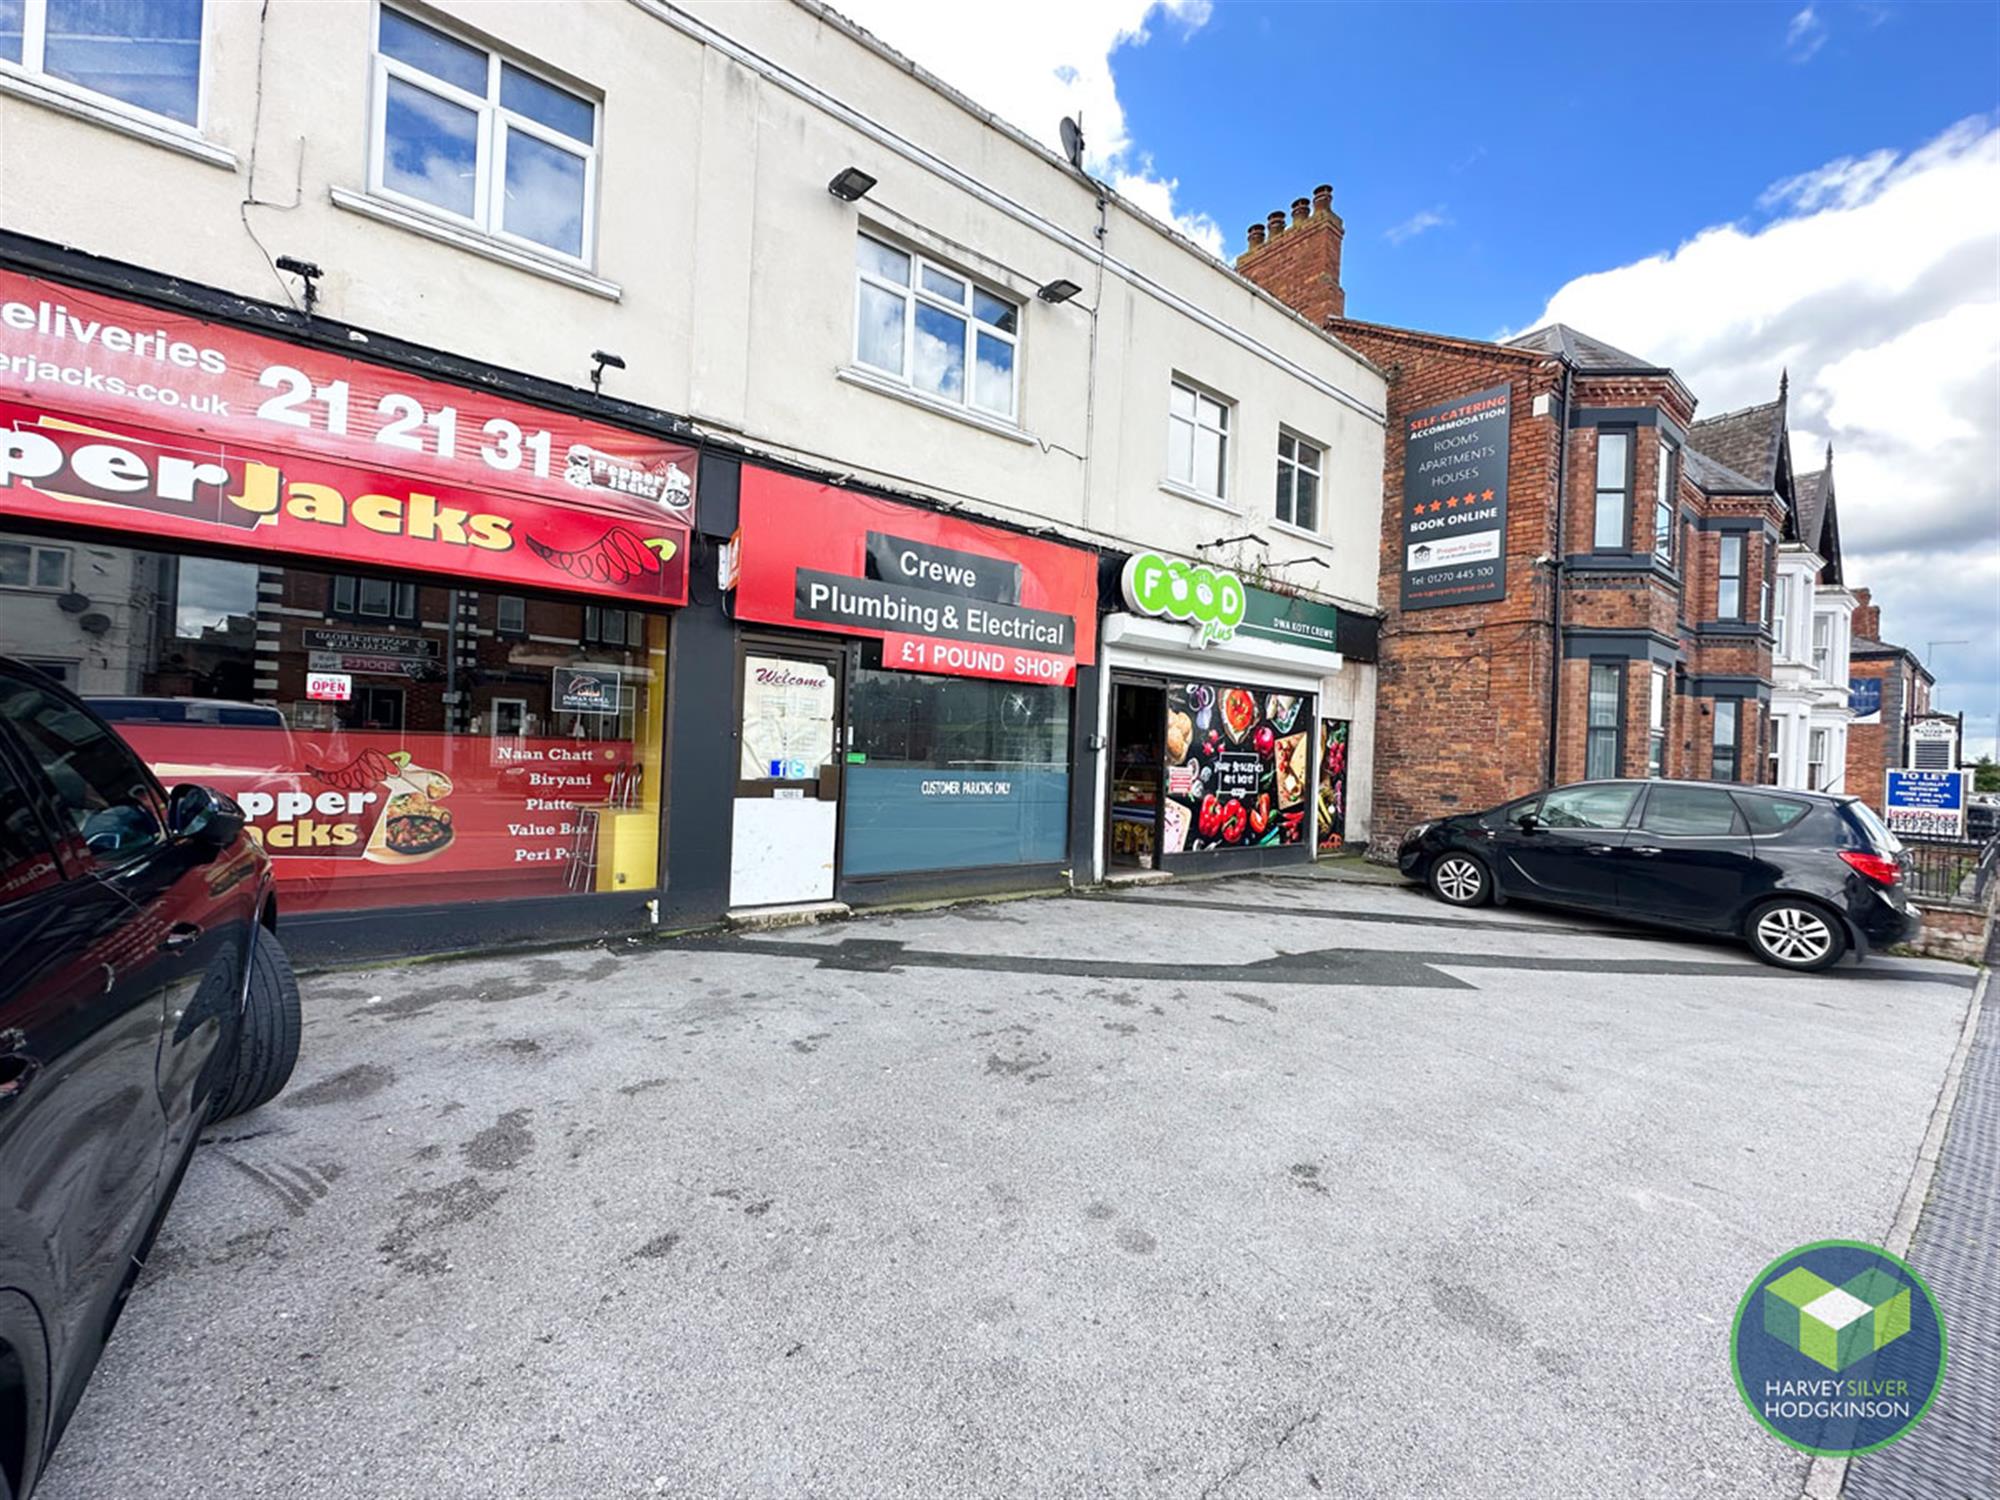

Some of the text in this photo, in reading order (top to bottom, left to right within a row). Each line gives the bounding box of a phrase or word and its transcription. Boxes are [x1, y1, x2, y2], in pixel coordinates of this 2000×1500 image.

[0, 301, 228, 375] eliveries
[256, 365, 551, 479] 21 21 31
[1409, 396, 1506, 430] SELF CATERING
[1410, 407, 1506, 440] ACCOMMODATION
[1433, 431, 1480, 452] ROOMS
[1418, 445, 1495, 473] APARTMENTS
[594, 459, 665, 487] Pepper
[1431, 466, 1479, 487] HOUSES
[0, 428, 513, 551] per Jacks
[1410, 507, 1497, 532] BOOK ONLINE
[900, 551, 976, 587] Crewe
[1427, 572, 1454, 584] 01270
[1456, 569, 1474, 579] 445
[1477, 566, 1494, 577] 100
[1144, 568, 1238, 614] FOOD
[810, 583, 1064, 646] Plumbing & Electrical
[1202, 622, 1233, 646] plus
[1292, 622, 1310, 634] KOTY
[1311, 626, 1333, 639] CREWE
[902, 641, 1063, 678] £1 POUND SHOP
[312, 680, 346, 692] OPEN
[755, 667, 826, 688] Welcome
[498, 747, 593, 760] Naan Chatt
[529, 773, 592, 788] Biryani
[921, 781, 1011, 795] CUSTOMER PARKING ONLY
[1901, 772, 1948, 781] TO LET
[237, 792, 377, 822] pper
[508, 824, 556, 836] Value
[515, 849, 551, 861] Peri
